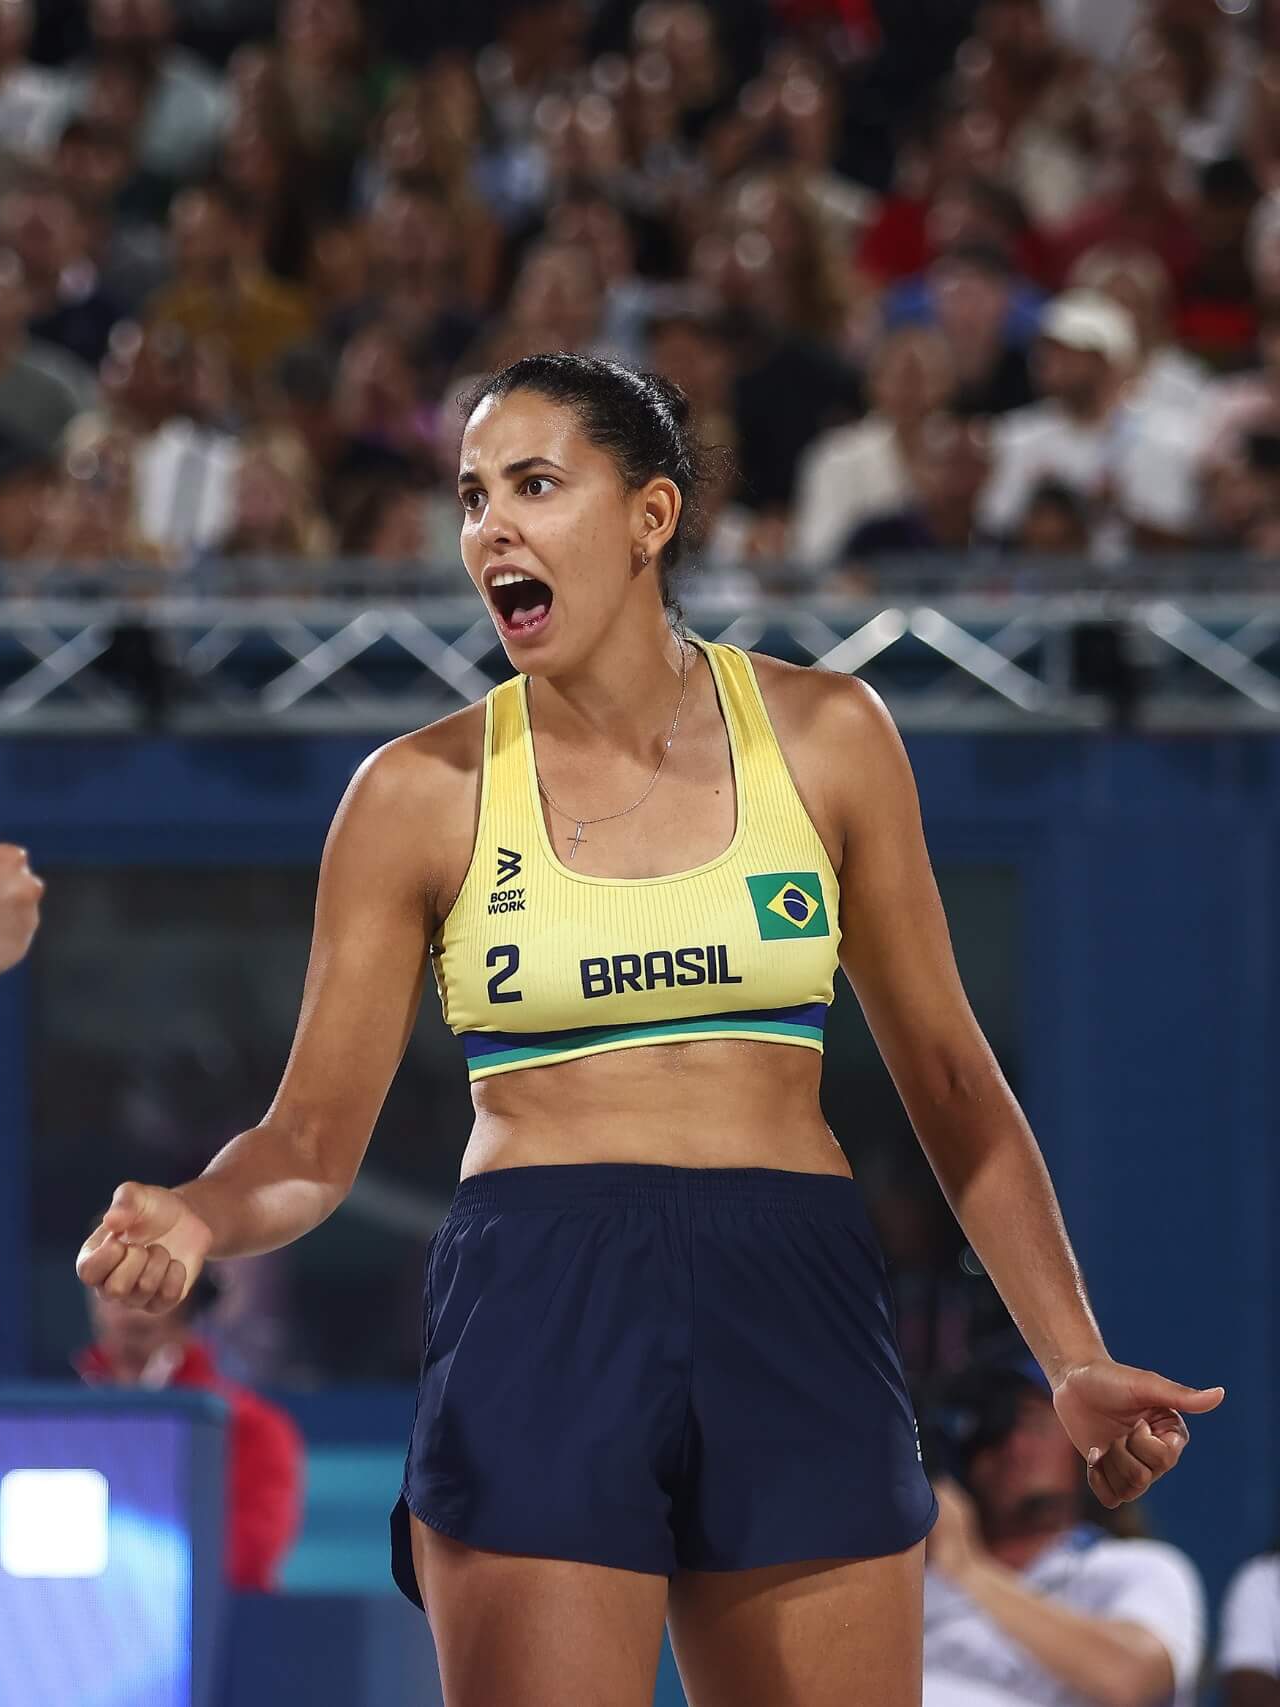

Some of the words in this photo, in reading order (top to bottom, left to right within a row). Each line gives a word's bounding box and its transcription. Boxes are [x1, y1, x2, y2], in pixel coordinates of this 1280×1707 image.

[490, 888, 526, 903] BODY
[488, 900, 526, 915] WORK
[486, 944, 522, 1004] 2
[580, 944, 742, 999] BRASIL
